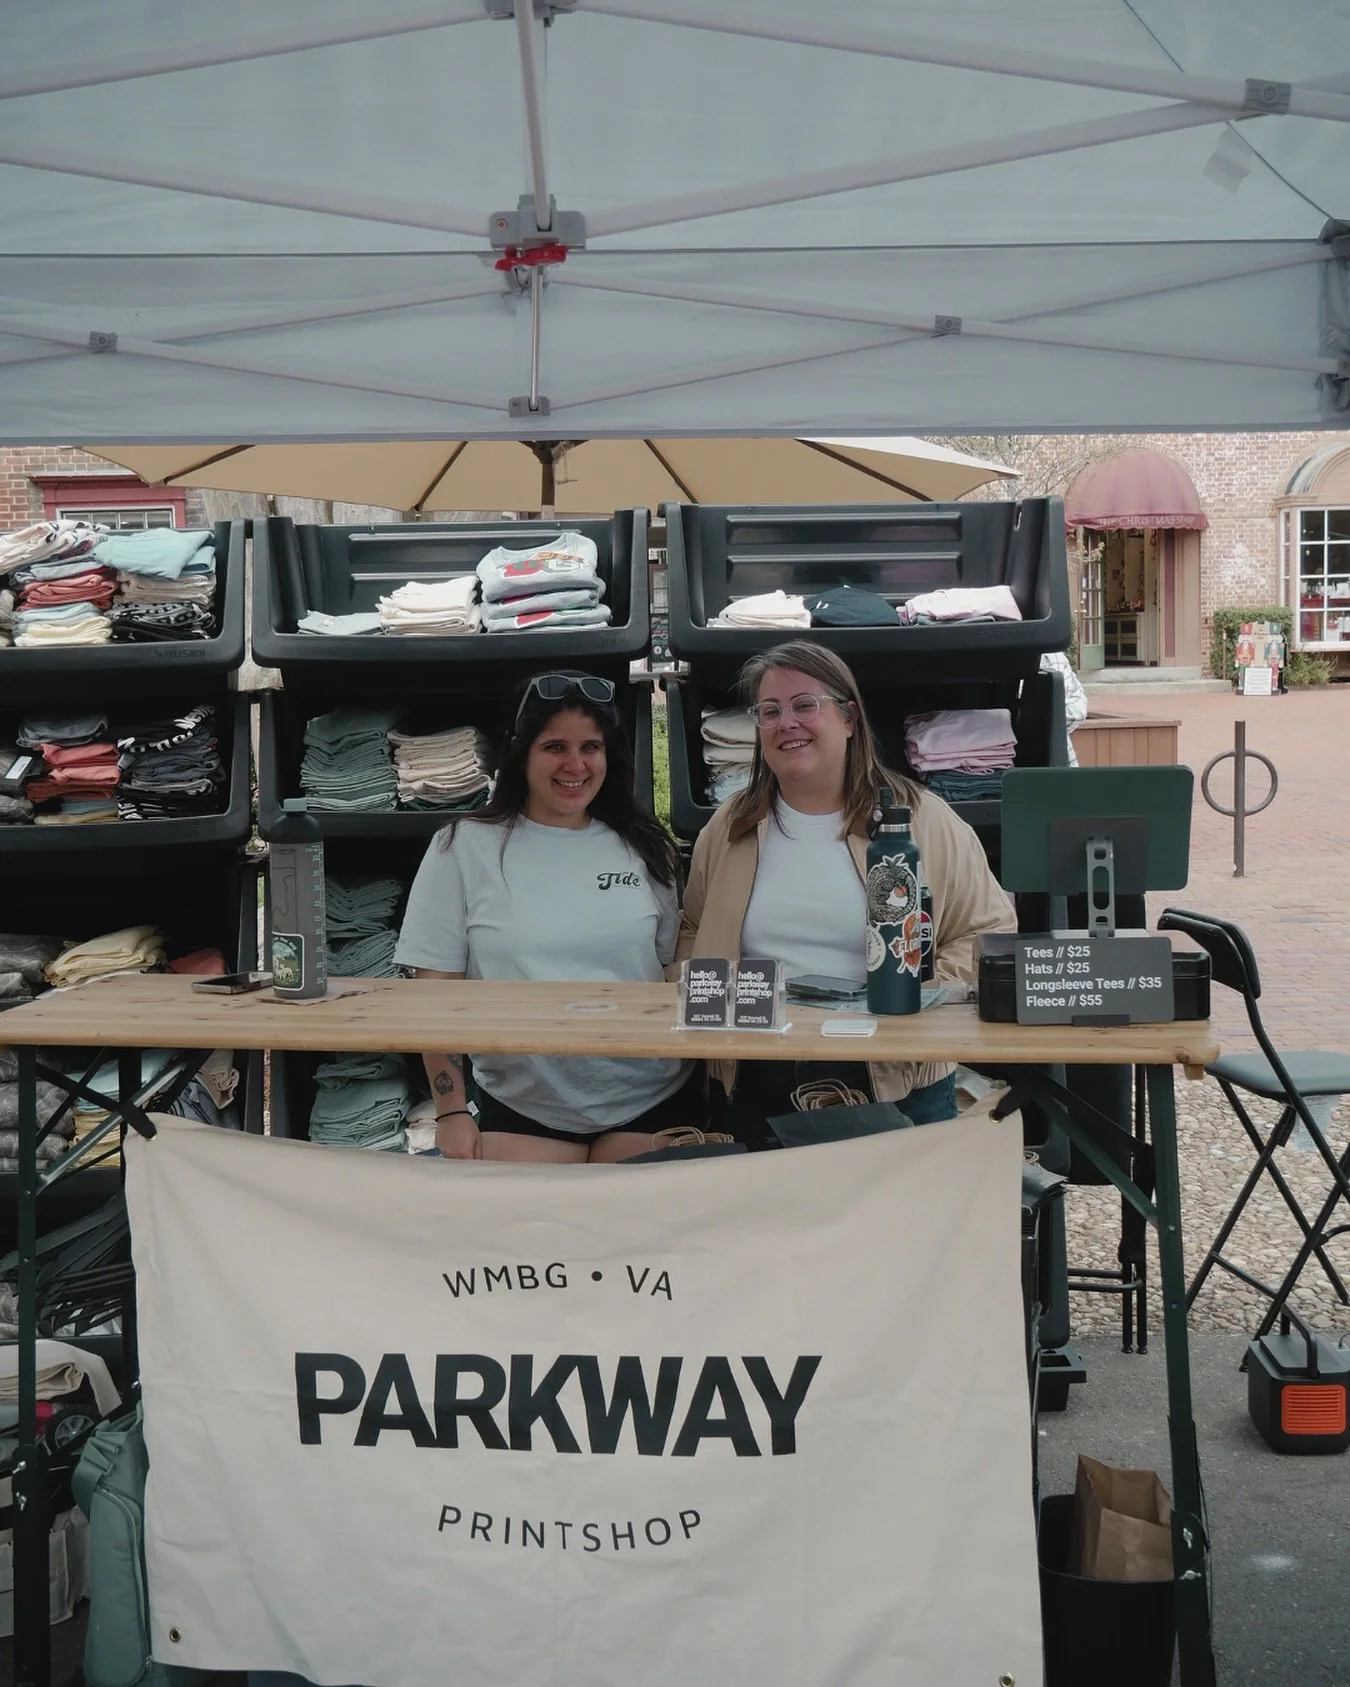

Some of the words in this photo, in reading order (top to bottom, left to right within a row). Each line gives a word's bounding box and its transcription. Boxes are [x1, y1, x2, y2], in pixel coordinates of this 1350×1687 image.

[1119, 515, 1175, 526] CHRISTMAS
[597, 872, 640, 890] Tide
[1024, 947, 1053, 958] Tees
[1055, 946, 1064, 958] //
[1067, 945, 1090, 958] $25
[1025, 963, 1053, 974] Hats
[1055, 963, 1064, 974] //
[1067, 961, 1090, 974] $25
[691, 971, 717, 980] hello@
[738, 971, 764, 981] hello@
[691, 979, 722, 988] parkway
[737, 980, 770, 990] parkway
[1026, 978, 1093, 992] Longsleeve
[1095, 978, 1125, 989] Tees
[1127, 977, 1136, 989] //
[1138, 976, 1162, 989] $35
[690, 987, 724, 997] printshop
[737, 989, 772, 999] printshop
[1026, 995, 1065, 1007] Fleece
[1067, 994, 1076, 1007] //
[1079, 993, 1102, 1007] $55
[442, 1262, 568, 1298] WMBG
[626, 1265, 672, 1300] VA
[294, 1352, 822, 1457] PARKWAY
[438, 1504, 701, 1552] PRINTSHOP
